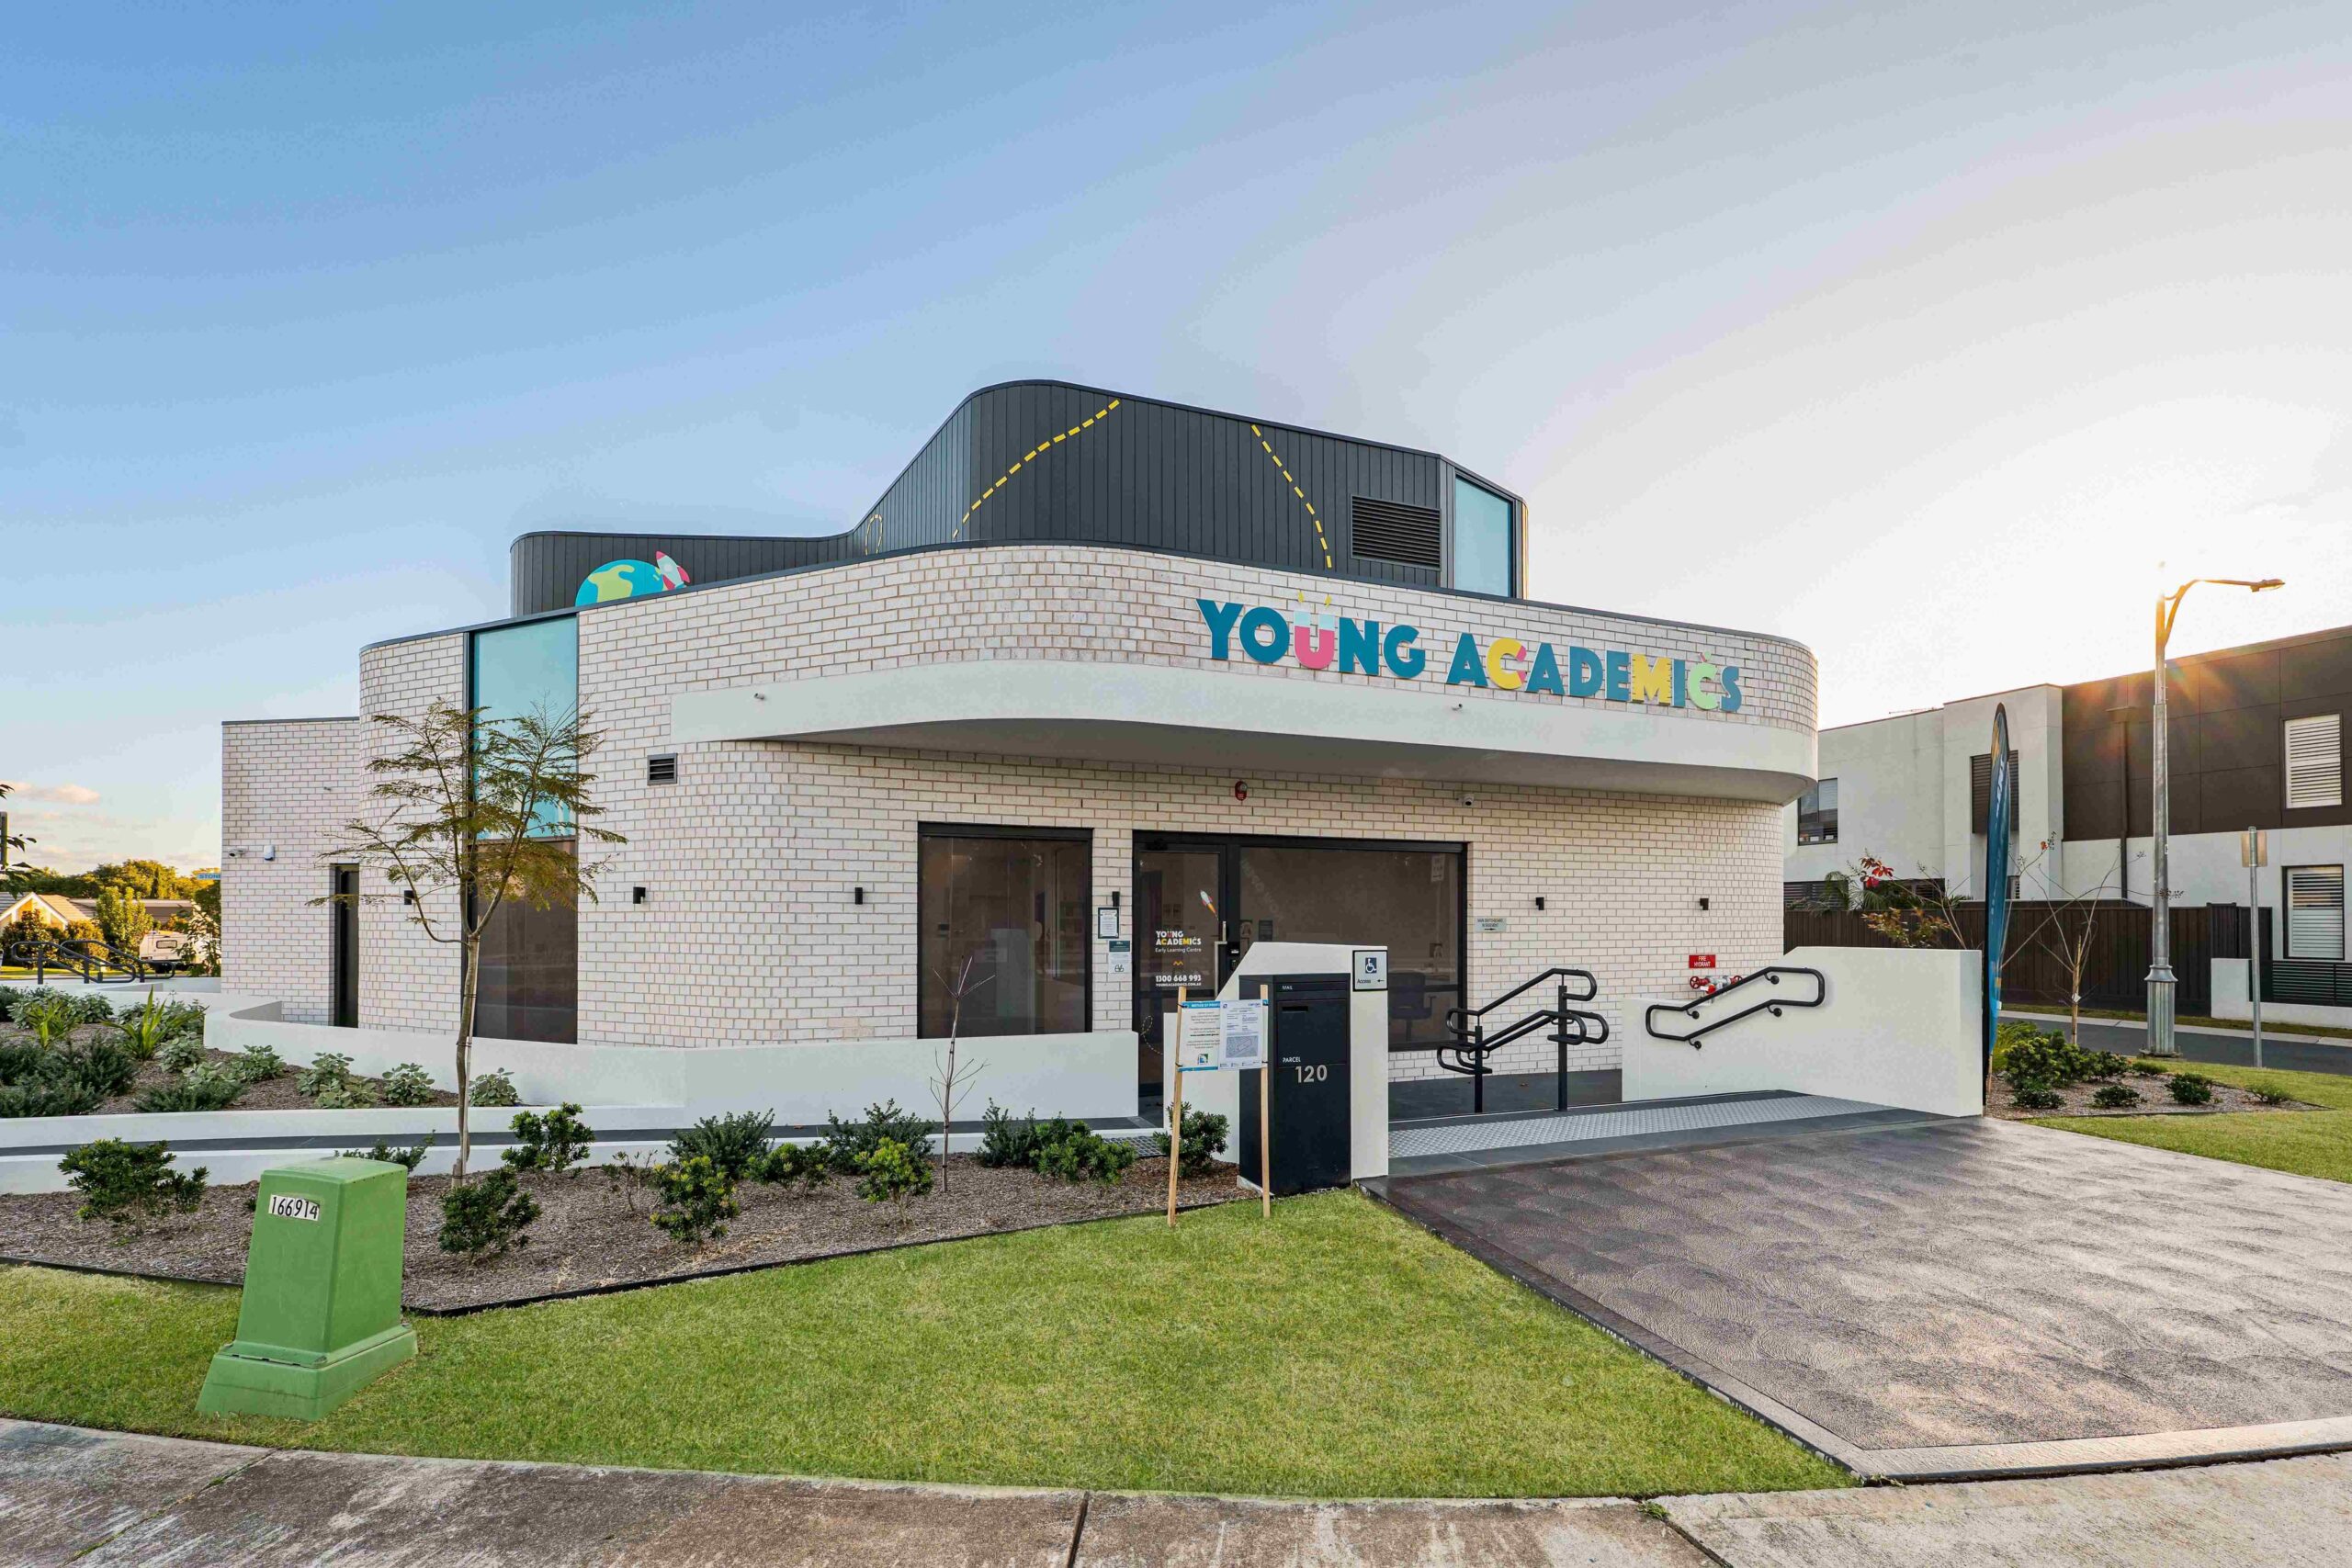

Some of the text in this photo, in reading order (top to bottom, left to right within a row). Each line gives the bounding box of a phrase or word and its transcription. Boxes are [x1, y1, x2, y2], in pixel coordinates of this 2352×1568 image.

[1195, 597, 1742, 713] YOUNG ACADEMICS
[1156, 937, 1202, 945] ACADEMICS
[1295, 1065, 1328, 1084] 120
[272, 1196, 318, 1219] 166914
